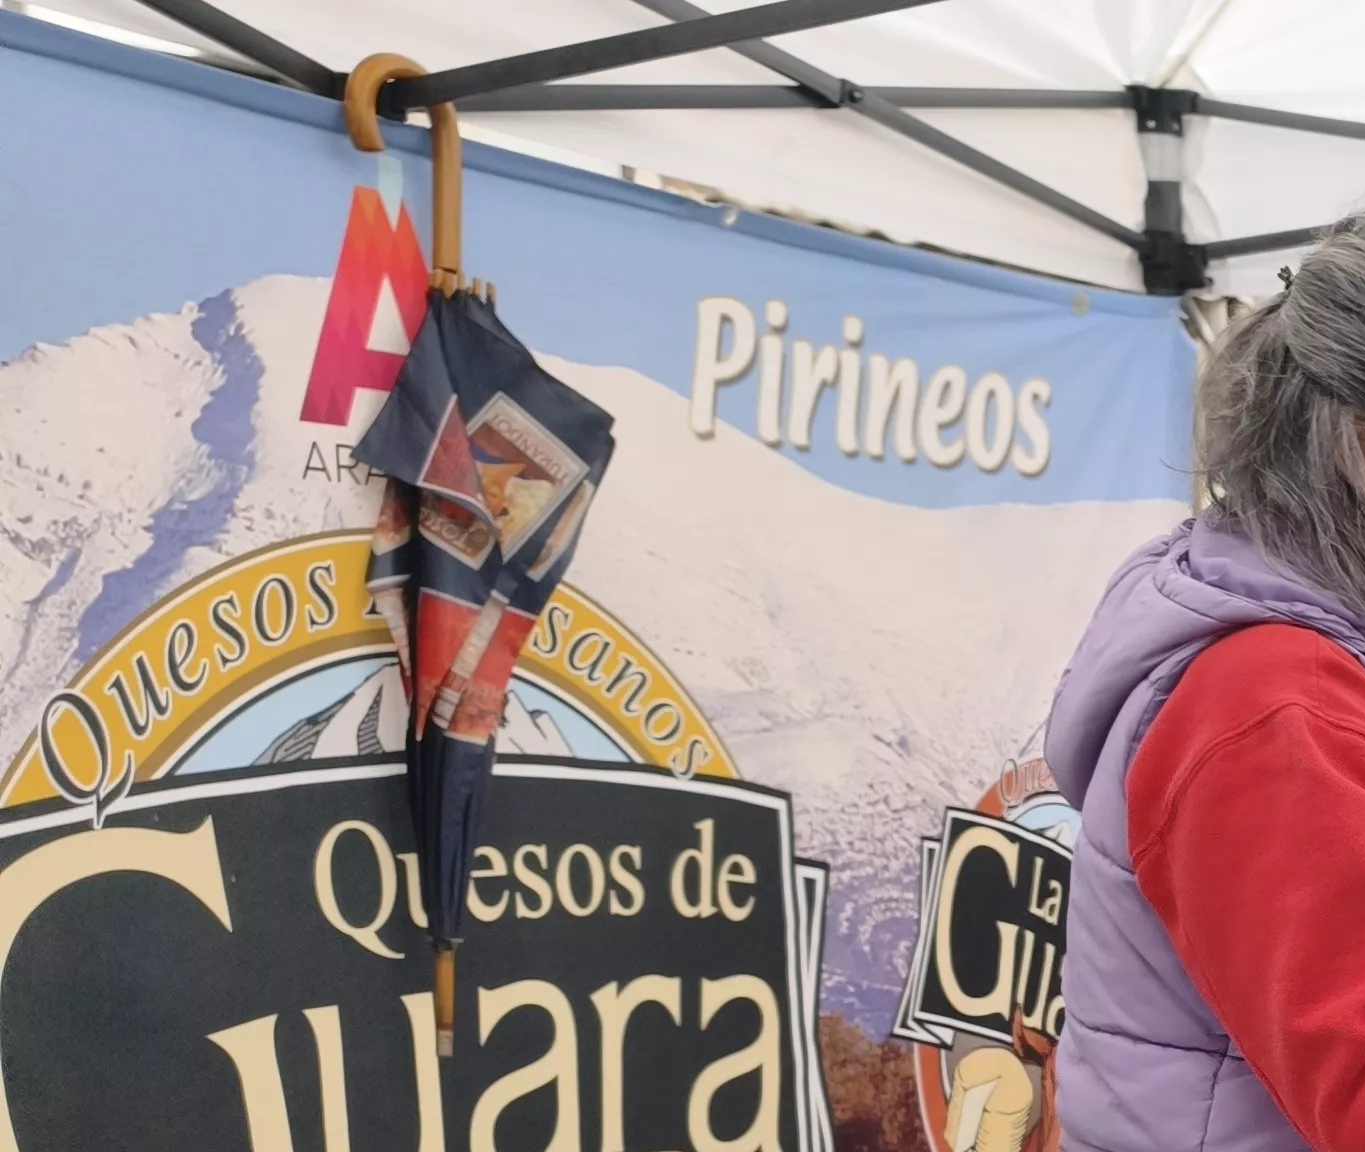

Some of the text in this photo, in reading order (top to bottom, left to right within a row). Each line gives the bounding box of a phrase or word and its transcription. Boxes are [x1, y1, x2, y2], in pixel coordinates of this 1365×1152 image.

[689, 295, 1052, 478] Pirineos
[39, 560, 339, 829] Quesos
[670, 820, 758, 922] de
[1028, 855, 1064, 927] La
